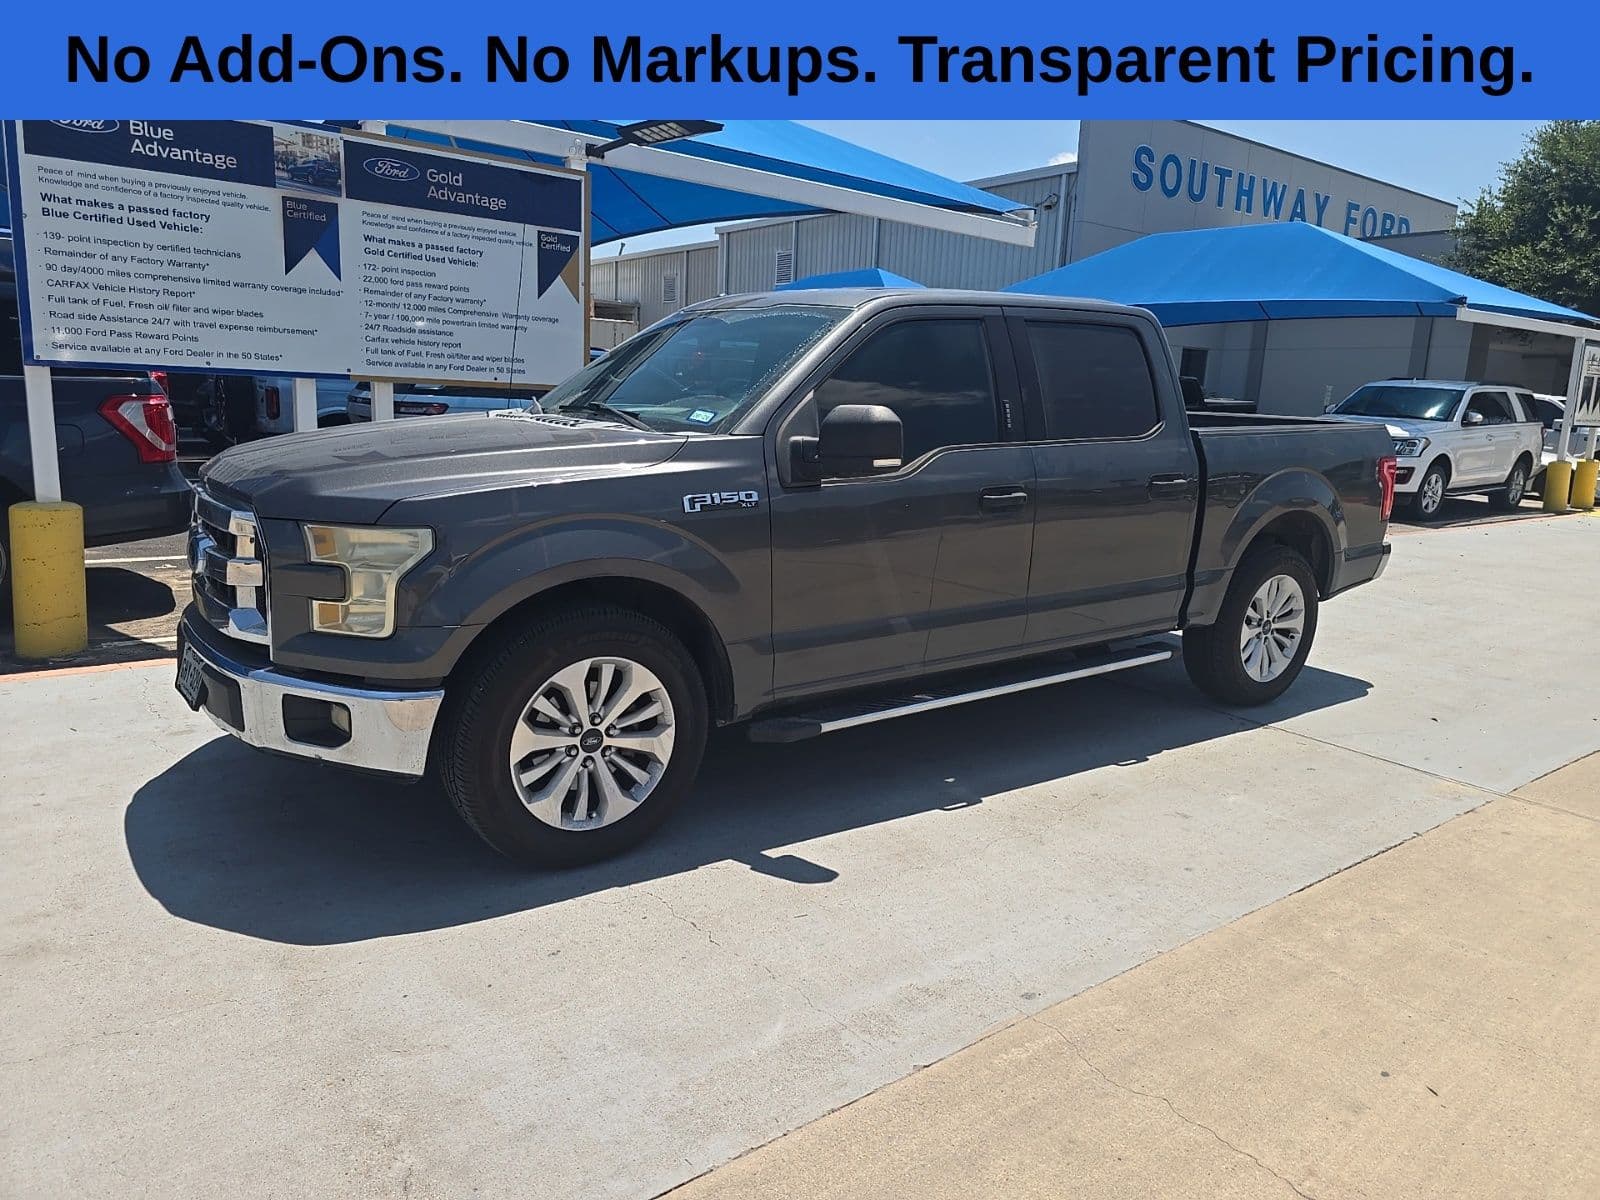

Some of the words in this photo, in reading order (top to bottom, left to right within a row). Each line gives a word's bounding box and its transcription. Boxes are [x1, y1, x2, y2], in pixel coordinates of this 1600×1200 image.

[130, 120, 174, 140] Blue
[130, 139, 238, 170] Advantage
[374, 160, 409, 178] Ford
[426, 168, 463, 186] Gold
[1131, 144, 1330, 227] SOUTHWAY
[39, 192, 73, 205] What
[75, 198, 115, 210] makes
[127, 204, 169, 216] passed
[172, 208, 211, 223] factory
[286, 200, 308, 210] Blue
[427, 186, 507, 210] Advantage
[41, 206, 70, 219] Blue
[72, 211, 124, 225] Certified
[126, 216, 157, 229] Used
[286, 210, 326, 222] Certified
[67, 234, 92, 244] point
[93, 236, 141, 248] inspection
[142, 241, 154, 252] by
[156, 244, 191, 254] certified
[193, 247, 242, 259] technicians
[362, 233, 386, 244] What
[388, 238, 416, 248] makes
[424, 243, 454, 252] passed
[456, 245, 484, 258] factory
[540, 233, 558, 242] Gold
[540, 242, 570, 252] Certified
[44, 247, 98, 259] Remainder
[99, 252, 109, 260] of
[111, 255, 128, 264] any
[130, 255, 165, 268] Factory
[363, 247, 385, 257] Gold
[387, 250, 423, 261] Certified
[424, 254, 446, 264] Used
[45, 262, 58, 272] 90
[60, 264, 104, 276] day/4000
[107, 268, 132, 278] miles
[133, 272, 201, 284] comprehensive
[203, 277, 231, 287] limited
[232, 281, 269, 292] warranty
[270, 285, 307, 295] coverage
[46, 278, 90, 290] CARFAX
[92, 282, 126, 293] Vehicle
[128, 285, 161, 297] History
[47, 294, 66, 304] Full
[68, 296, 89, 305] tank
[91, 297, 101, 306] of
[128, 300, 155, 310] Fresh
[172, 304, 191, 313] filter
[211, 307, 235, 316] wiper
[236, 308, 264, 318] blades
[48, 310, 75, 320] Road
[77, 312, 98, 322] side
[98, 313, 149, 325] Assistance
[151, 317, 171, 326] 24/7
[173, 319, 191, 328] with
[193, 320, 217, 329] travel
[218, 323, 254, 332] expense
[85, 328, 107, 337] Ford
[109, 329, 133, 338] Pass
[135, 331, 170, 340] Reward
[171, 333, 199, 342] Points
[50, 341, 88, 351] Service
[90, 344, 131, 353] available
[144, 348, 161, 357] any
[163, 347, 184, 356] Ford
[186, 349, 215, 358] Dealer
[241, 352, 252, 360] 50
